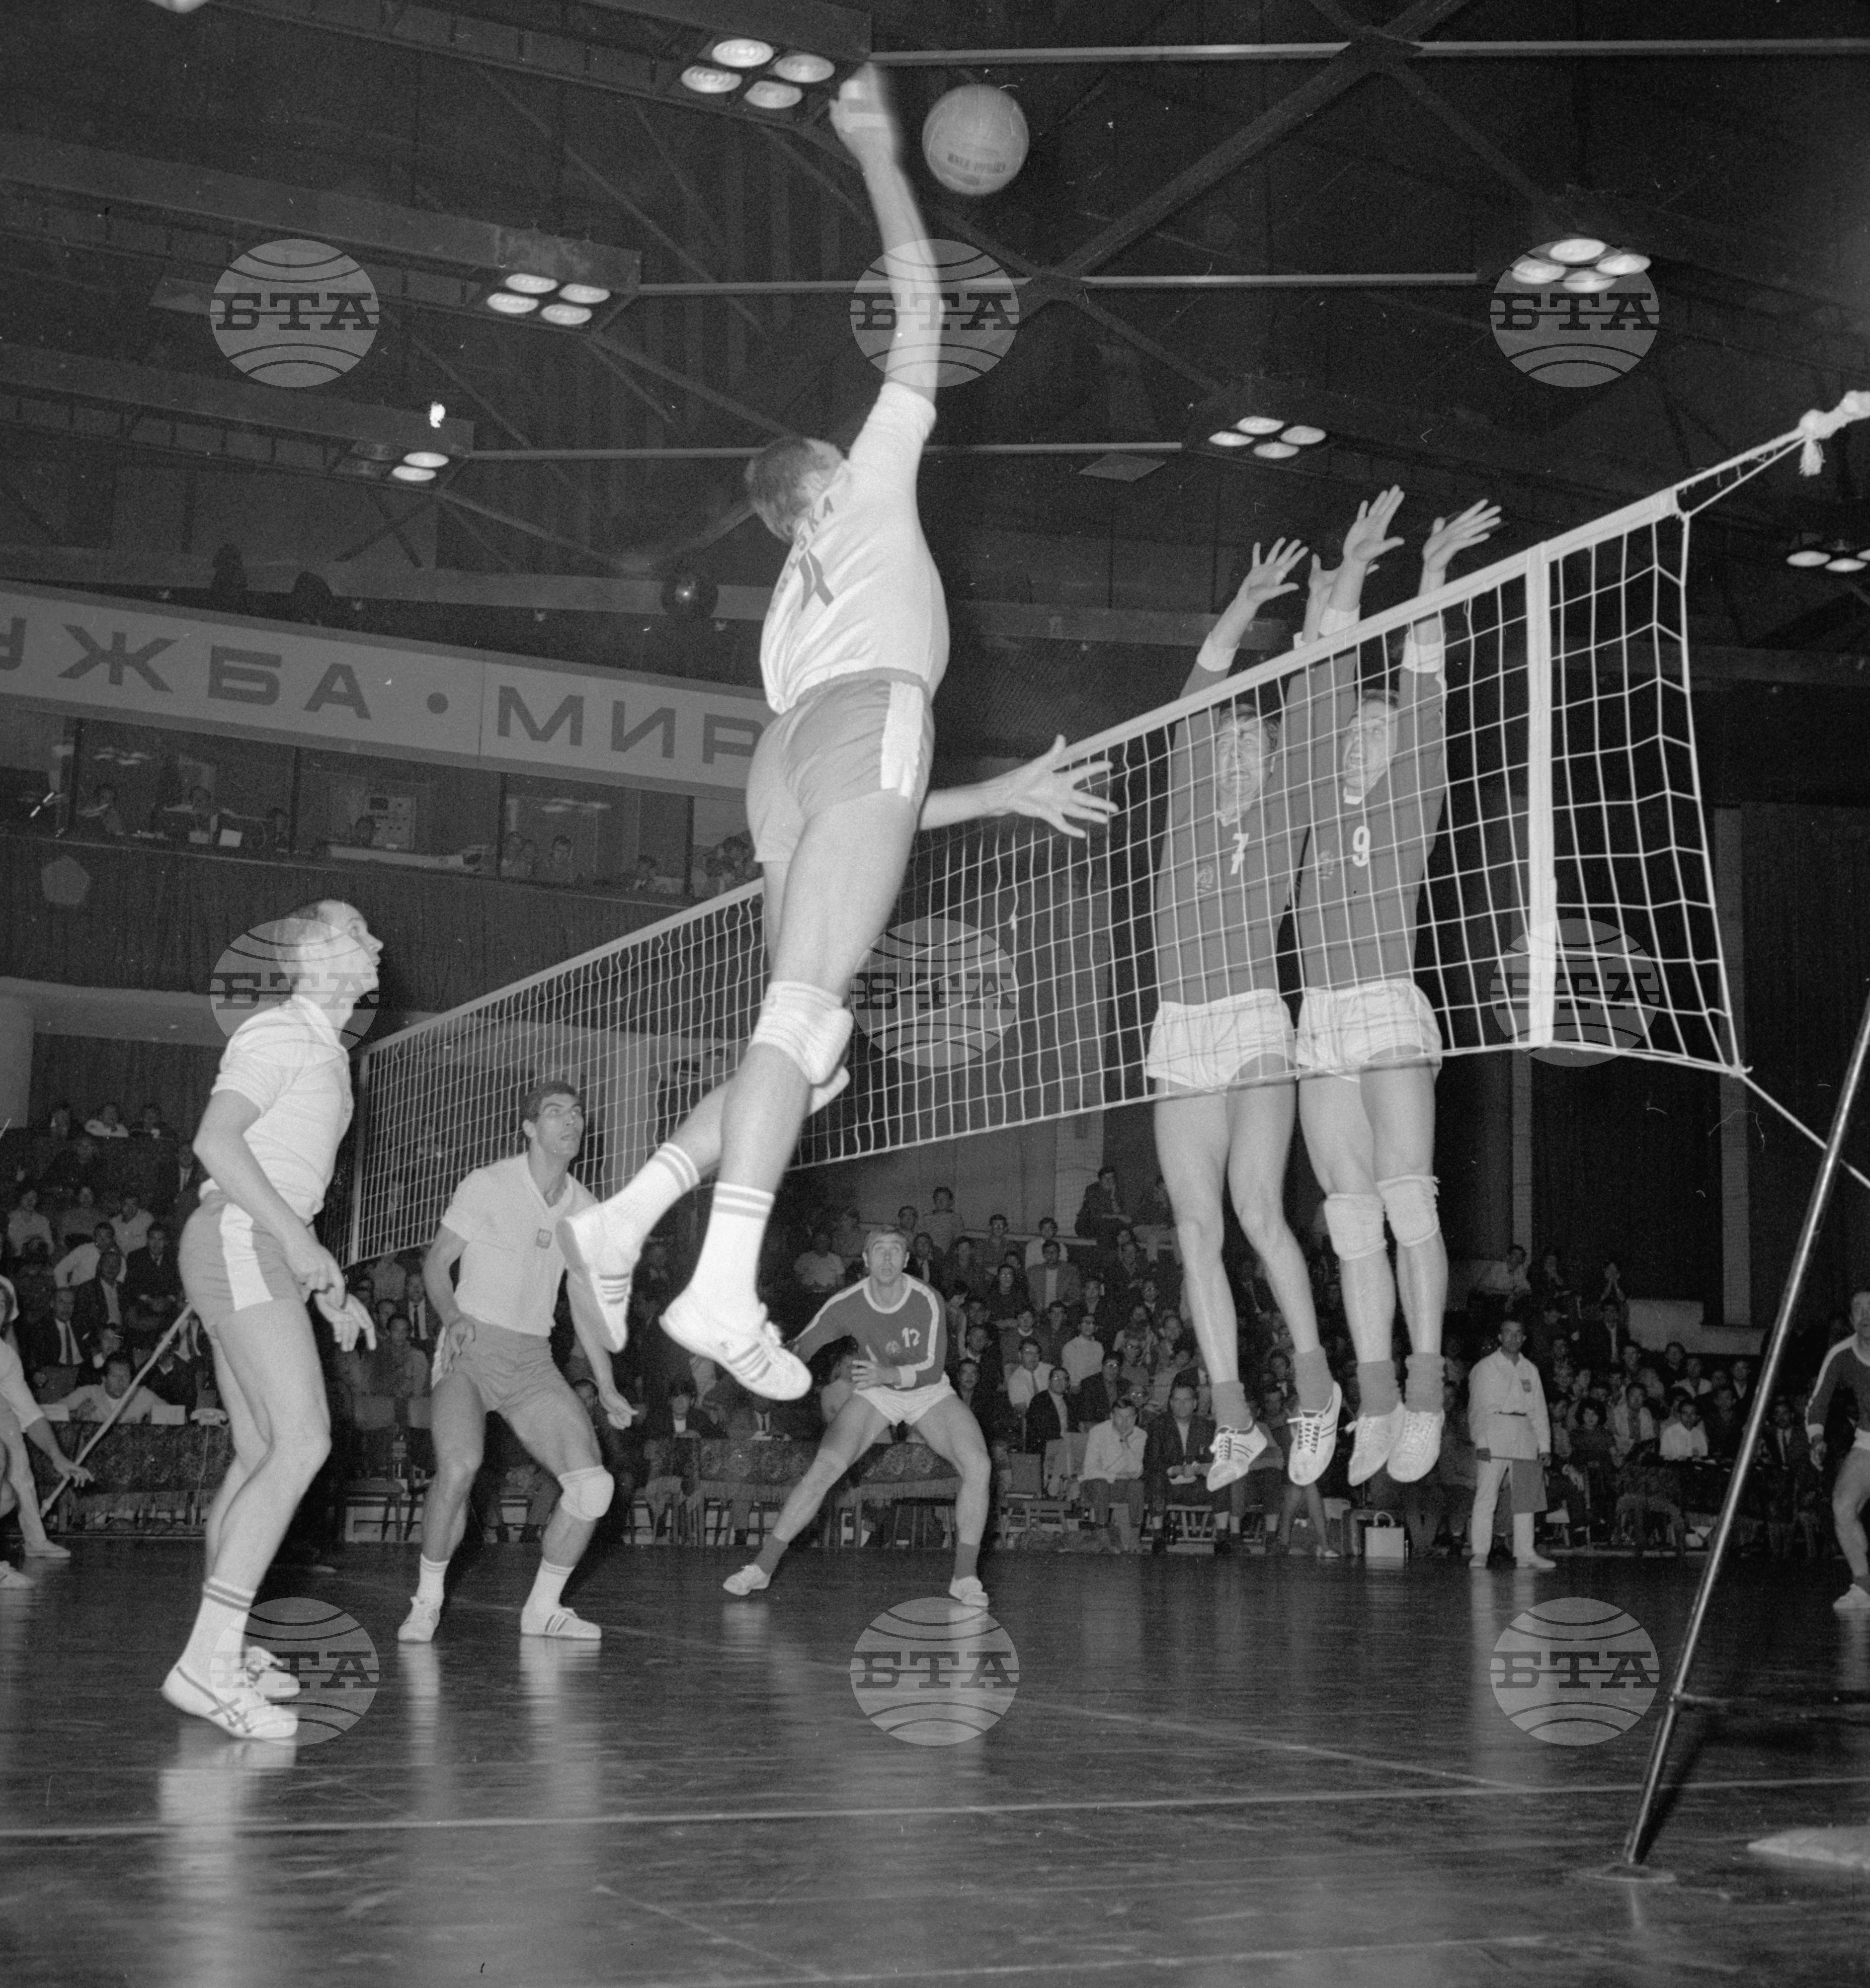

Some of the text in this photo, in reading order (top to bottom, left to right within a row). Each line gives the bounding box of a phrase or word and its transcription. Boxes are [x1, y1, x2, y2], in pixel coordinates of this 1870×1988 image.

[497, 685, 765, 764] МИР
[1230, 833, 1249, 875] 7
[1352, 825, 1371, 867] 9
